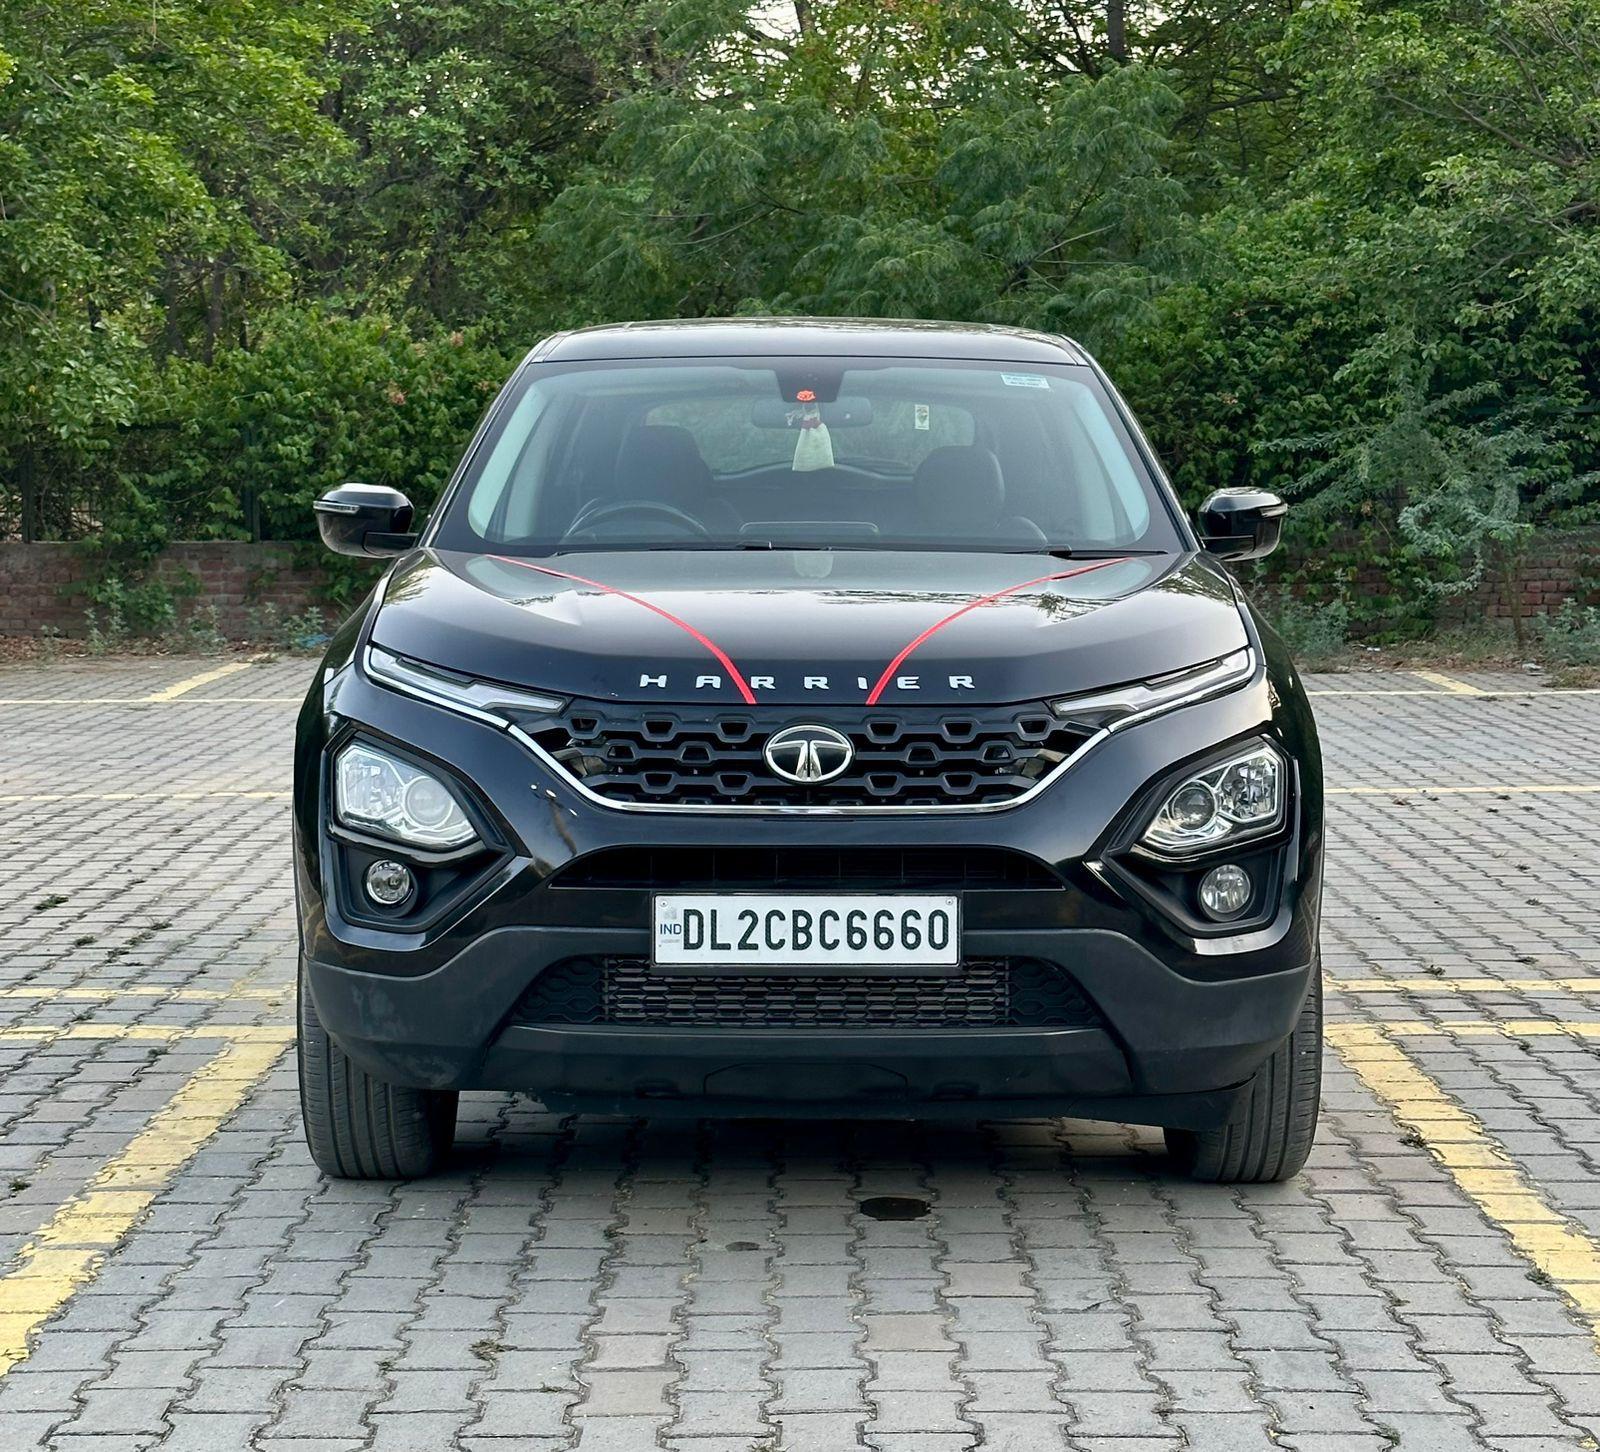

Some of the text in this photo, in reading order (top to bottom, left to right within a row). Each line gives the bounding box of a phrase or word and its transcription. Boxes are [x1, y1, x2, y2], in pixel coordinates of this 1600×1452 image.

[639, 674, 975, 690] HARRIER
[660, 923, 682, 935] IND
[683, 909, 949, 951] DL2CBC6660
